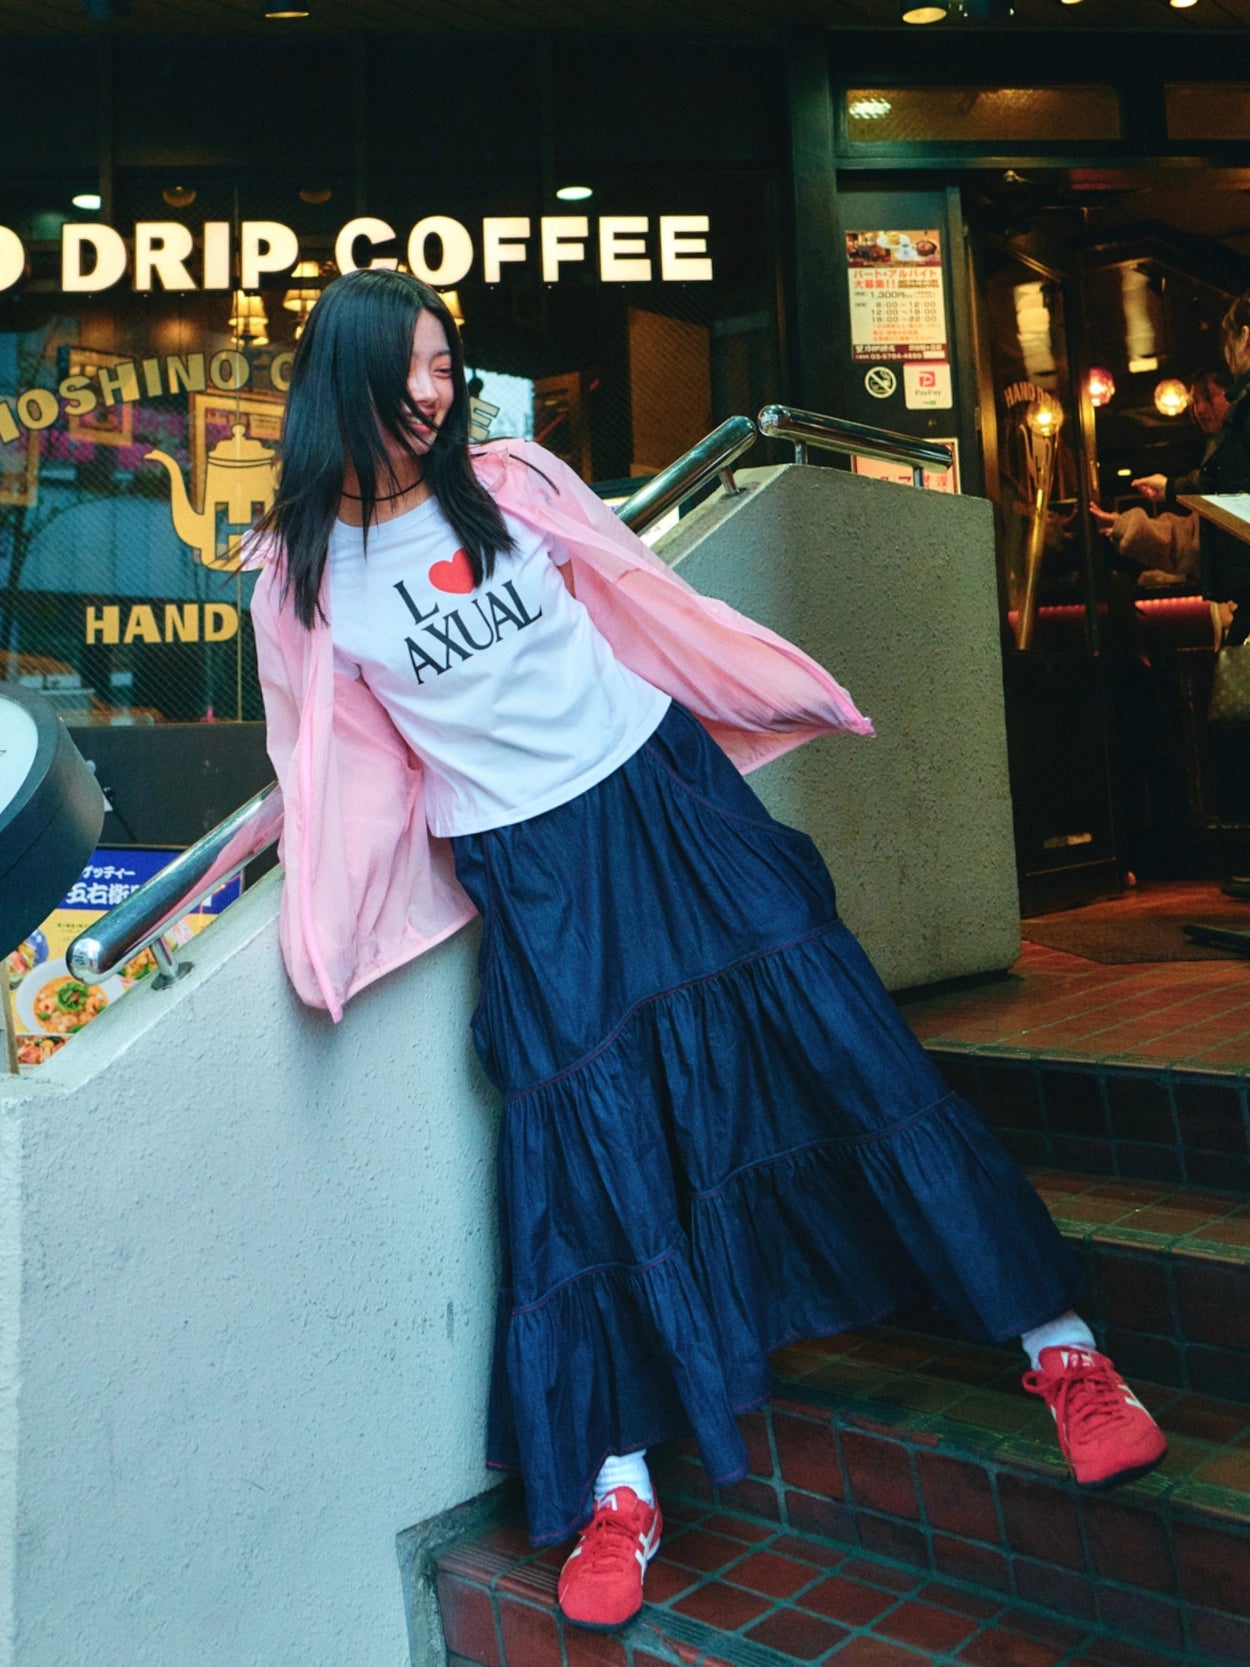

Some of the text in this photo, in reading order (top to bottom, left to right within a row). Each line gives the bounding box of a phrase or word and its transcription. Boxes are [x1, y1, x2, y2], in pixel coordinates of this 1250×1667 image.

[61, 221, 299, 292] DRIP
[335, 215, 713, 285] COFFEE
[86, 603, 239, 644] HAND
[393, 580, 440, 625] L
[404, 579, 543, 685] AXUAL
